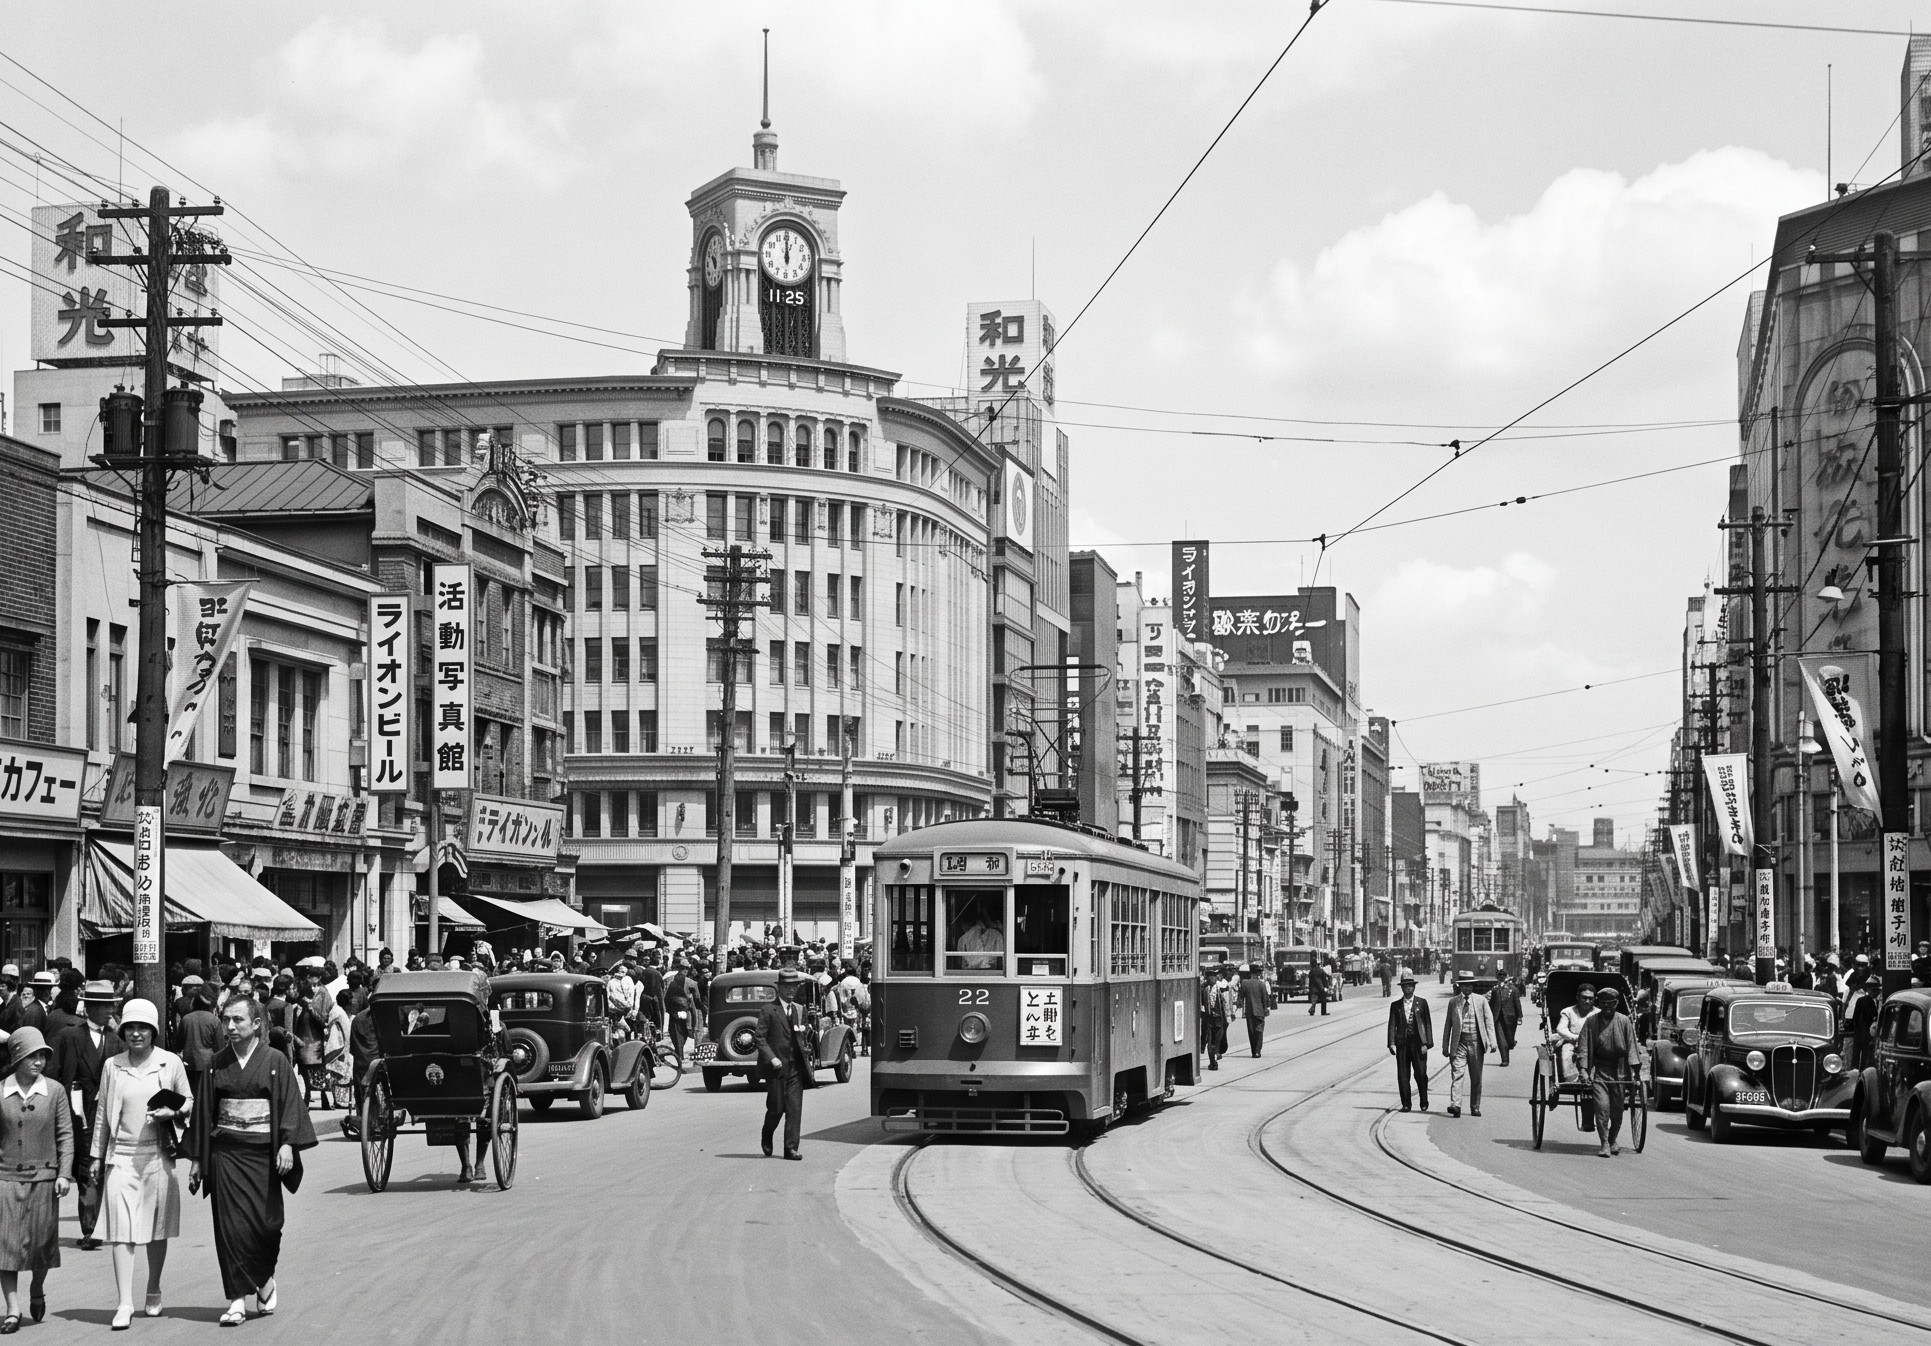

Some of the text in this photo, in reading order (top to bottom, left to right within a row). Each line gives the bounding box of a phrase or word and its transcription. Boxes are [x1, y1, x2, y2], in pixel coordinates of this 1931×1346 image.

[55, 211, 116, 345] 和光
[979, 309, 1027, 393] 和光
[375, 602, 403, 784] ライオンビール
[437, 581, 466, 772] 活動写真館
[0, 756, 77, 804] カフェー
[958, 988, 990, 1005] 22
